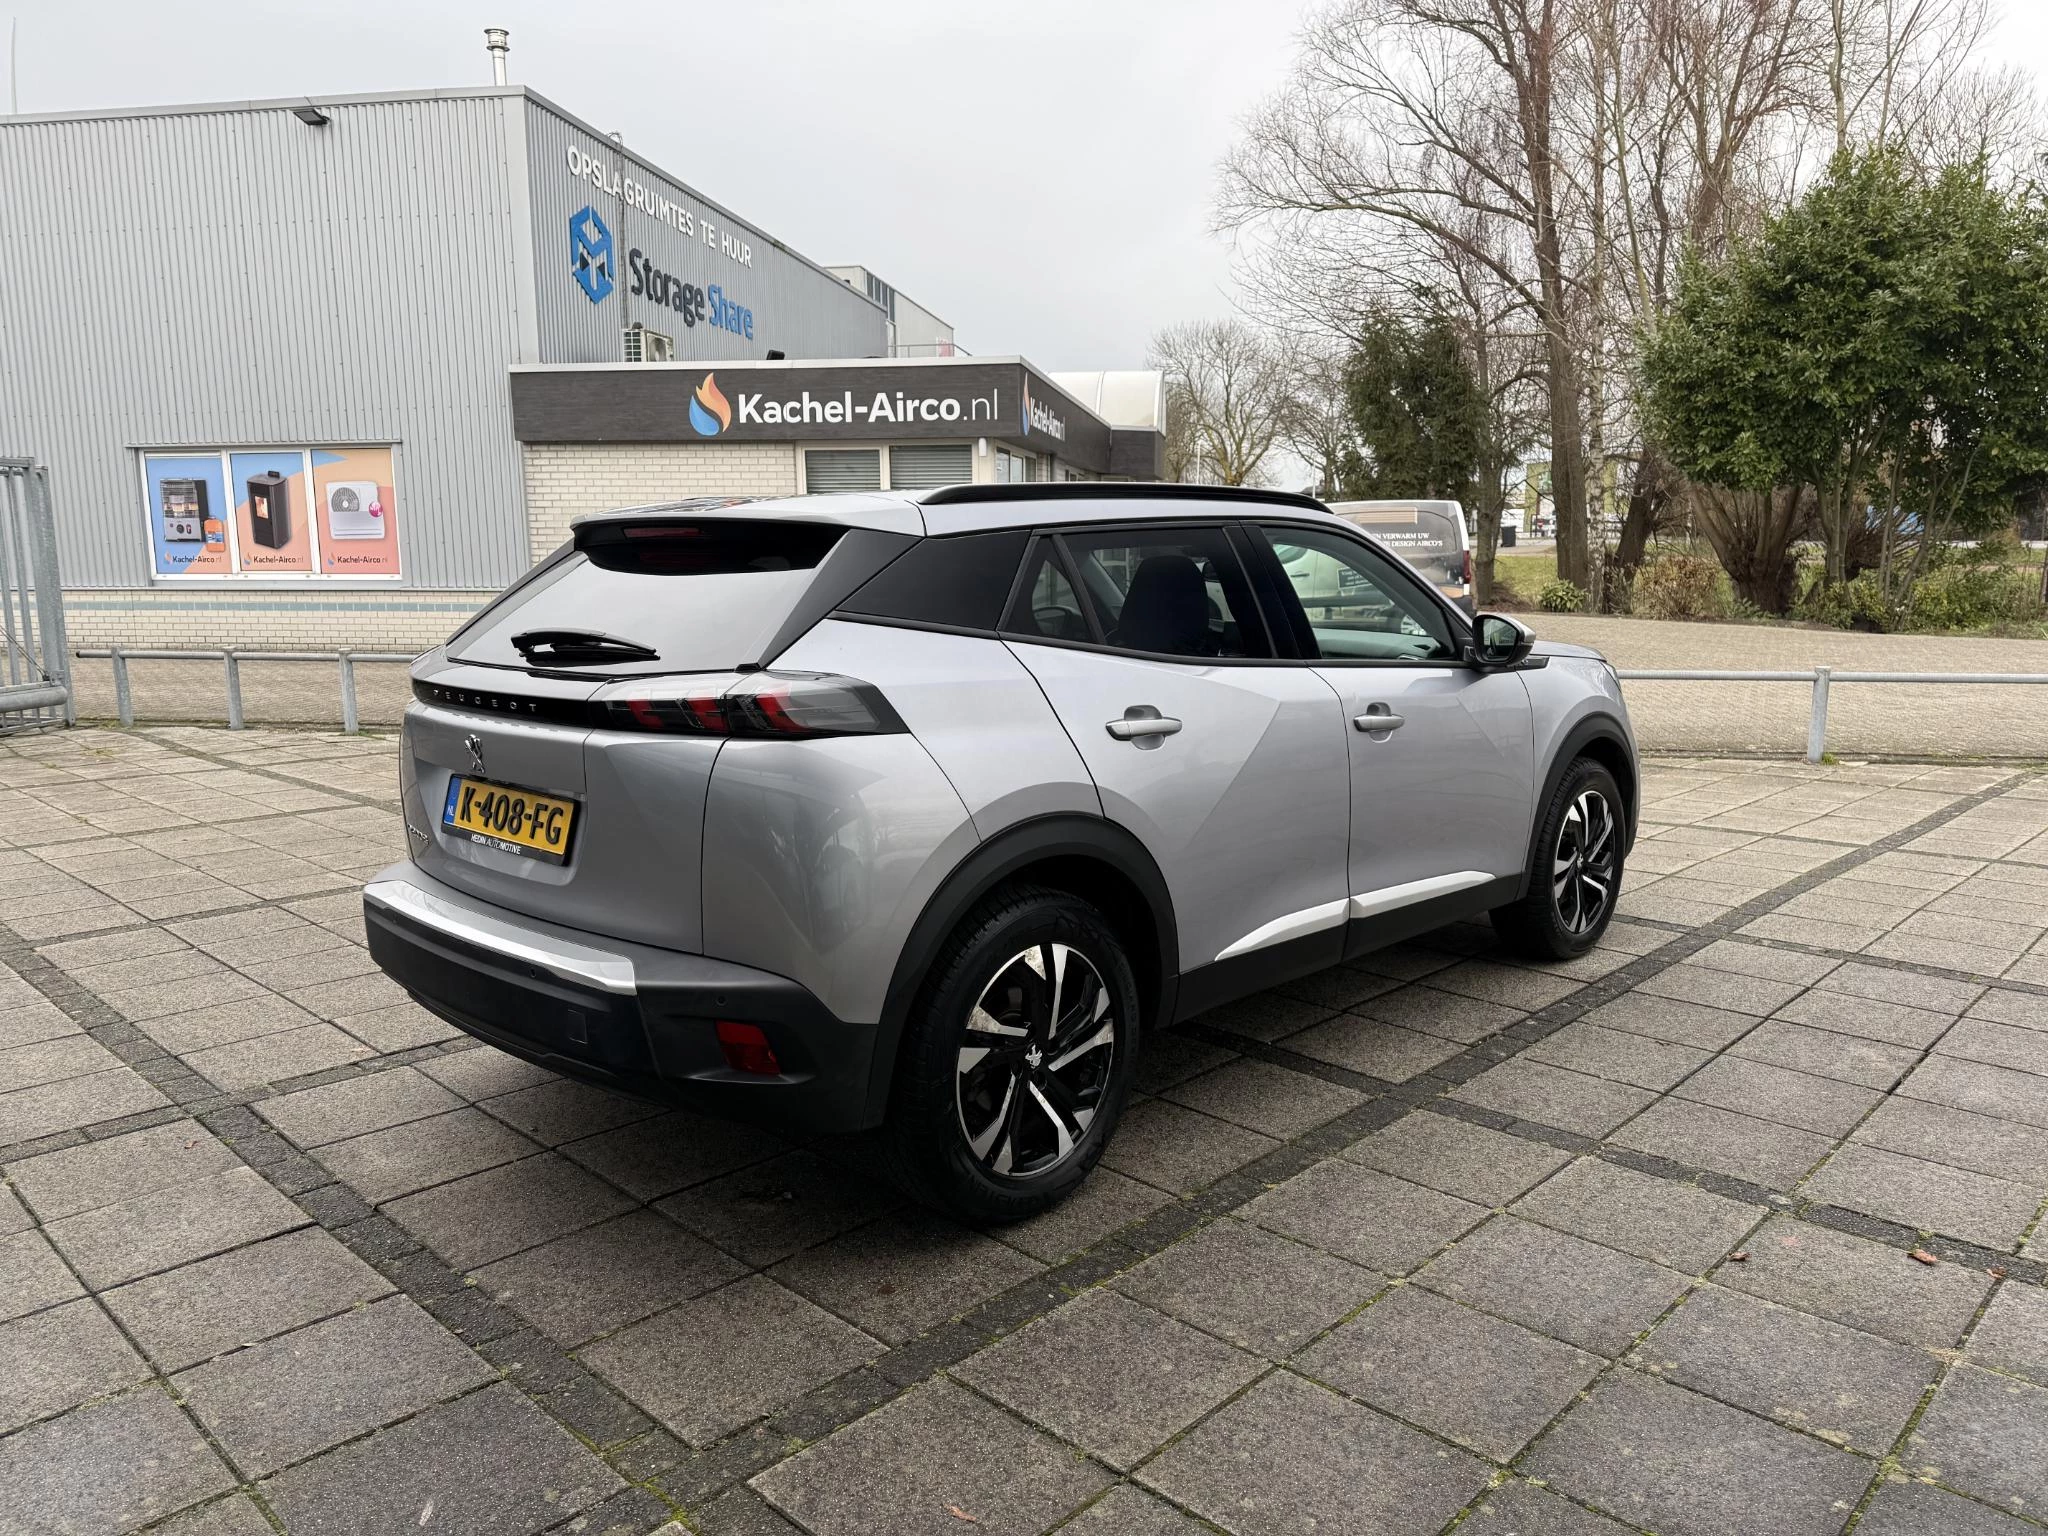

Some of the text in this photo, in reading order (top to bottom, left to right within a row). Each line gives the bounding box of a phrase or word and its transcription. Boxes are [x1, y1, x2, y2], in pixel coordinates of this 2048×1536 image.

[567, 145, 752, 268] OPSLAGRUIMTES TE HUUR
[738, 388, 998, 423] Kachel-Airco.nl
[1030, 396, 1065, 442] Kachel-Airco.nl
[433, 689, 536, 712] PEUGEOT
[447, 805, 454, 816] NL
[460, 786, 564, 845] K-408-FG
[486, 838, 521, 855] AUTOMOTIVE
